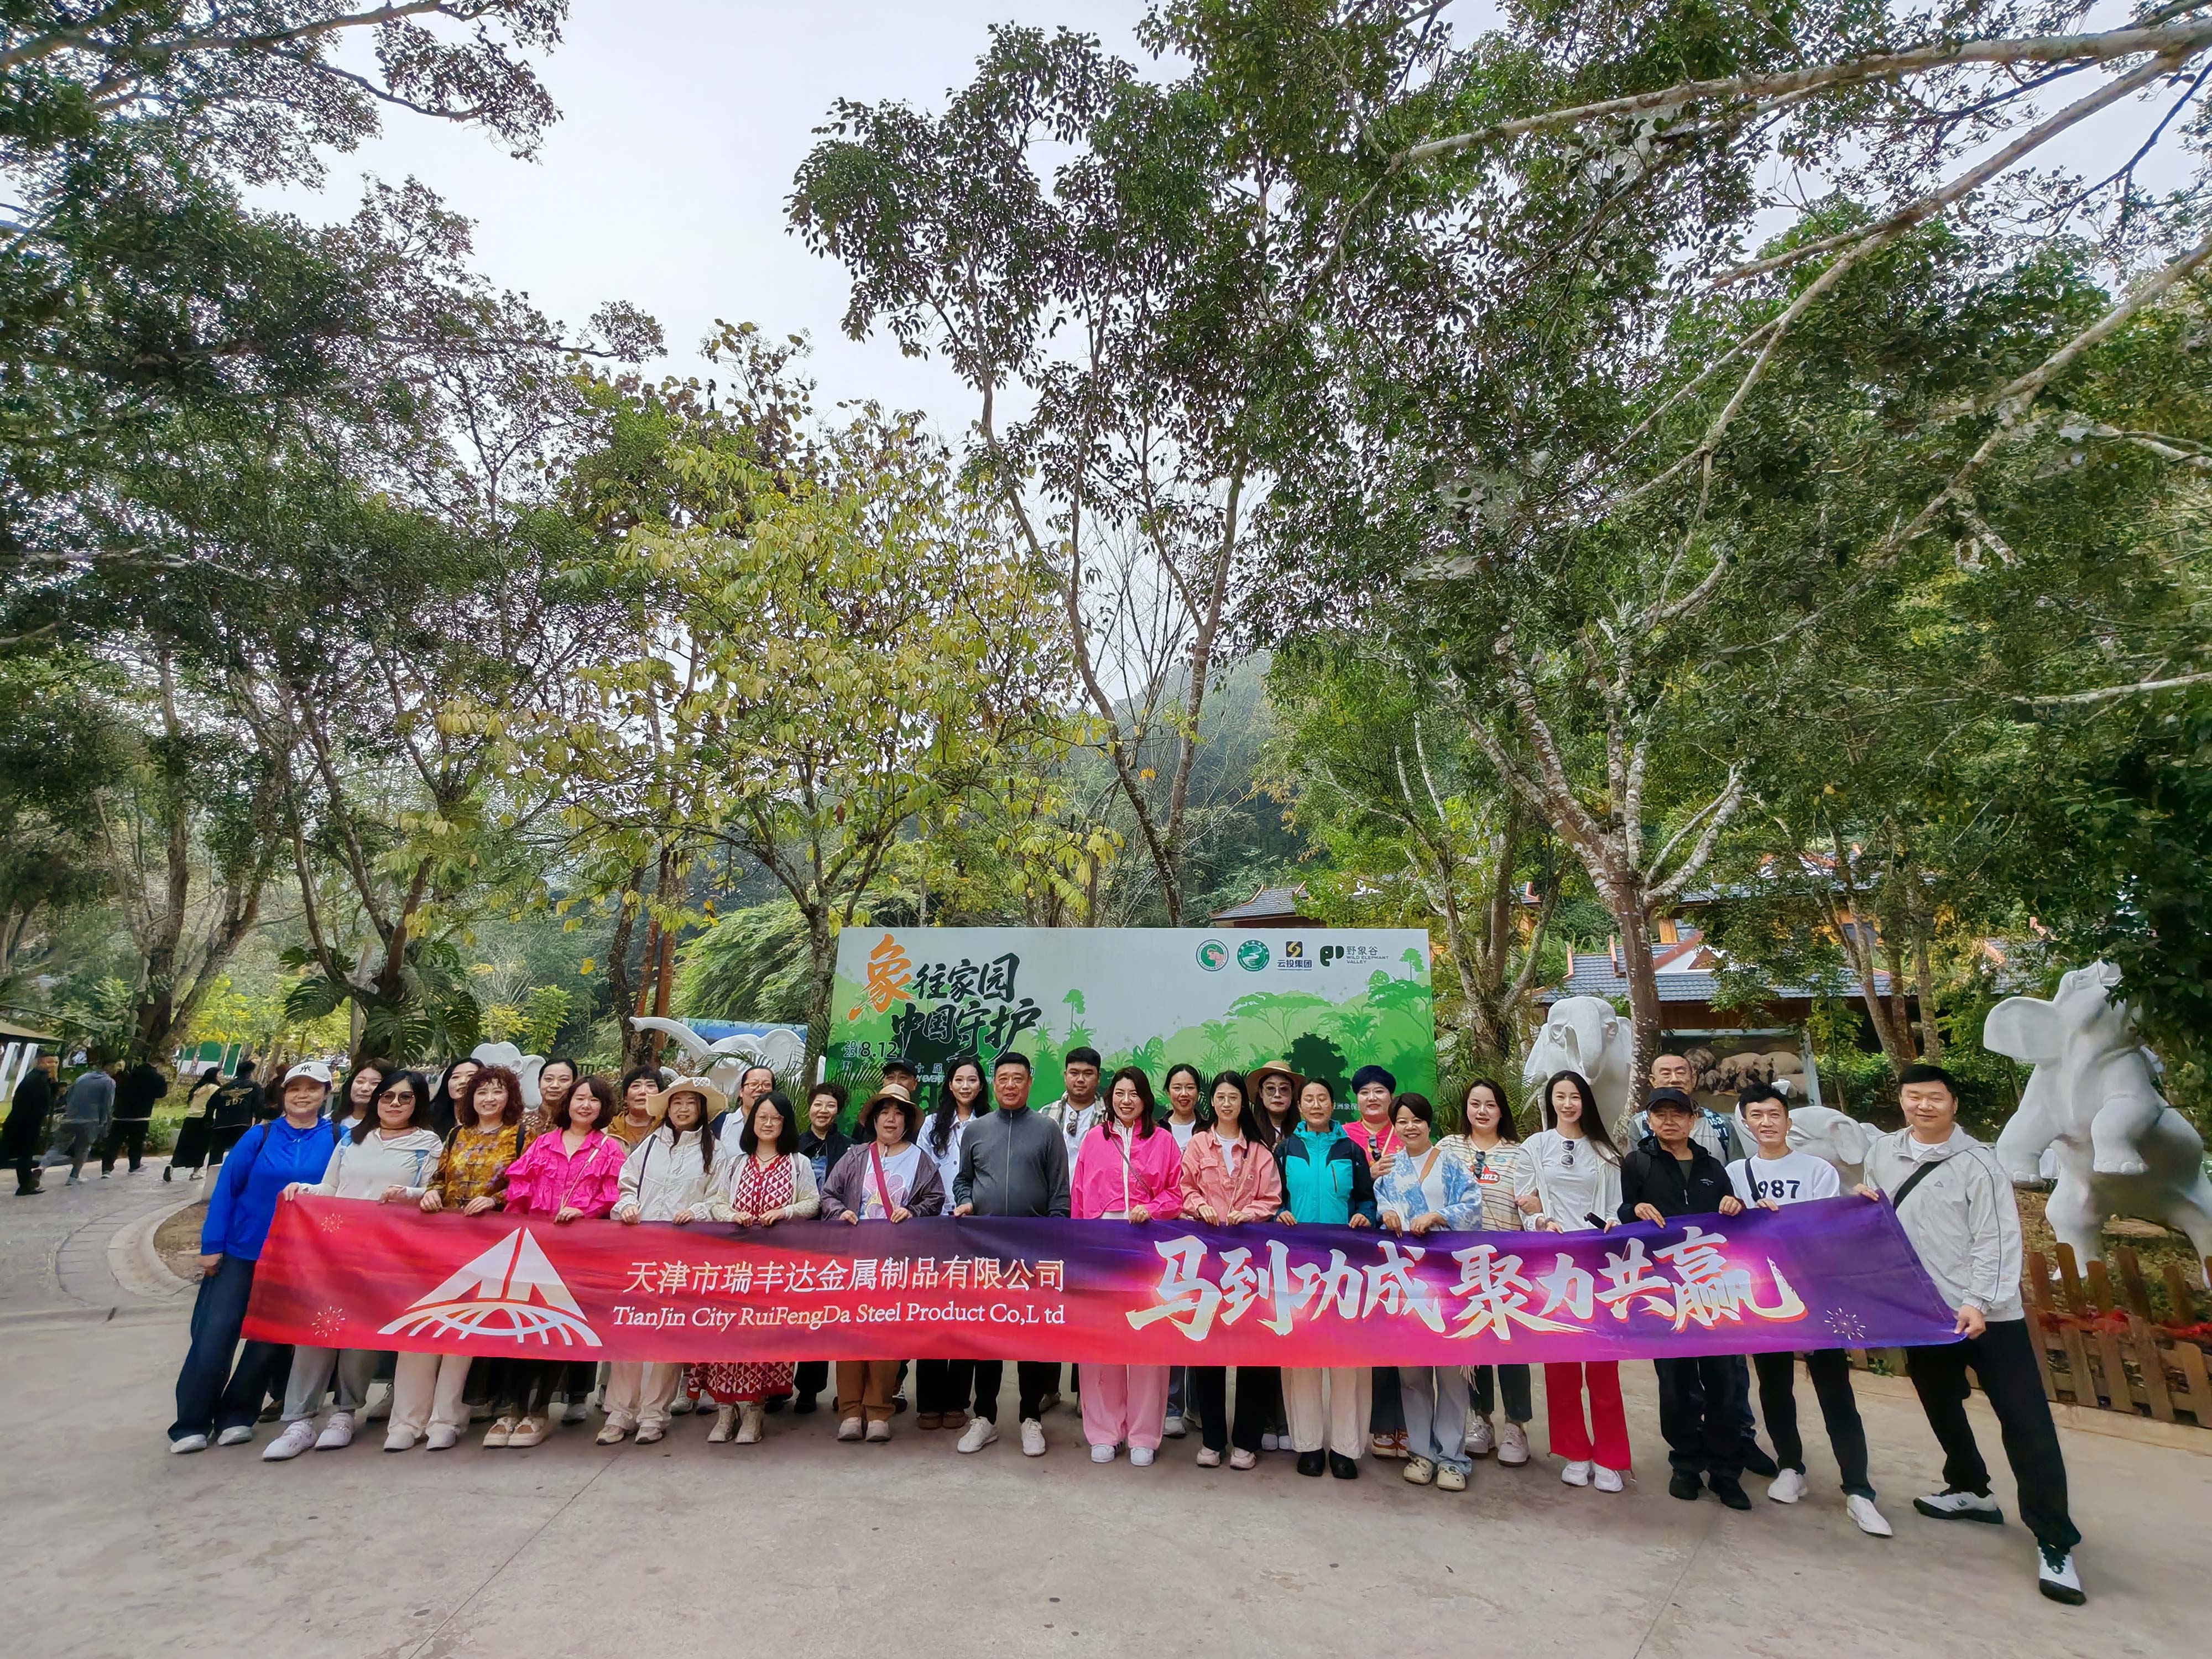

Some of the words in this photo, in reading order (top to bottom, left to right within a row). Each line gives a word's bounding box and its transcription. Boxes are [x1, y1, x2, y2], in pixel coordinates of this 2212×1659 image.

[1277, 959, 1312, 968] 云投集团
[1346, 946, 1378, 955] 野象谷
[891, 998, 1042, 1062] 中国守护
[860, 1041, 898, 1058] 8.12
[622, 1254, 1065, 1295] 天津市瑞丰达金属制品有限公司
[1125, 1235, 1446, 1342] 马到功成
[1441, 1226, 1807, 1342] 聚力共赢
[613, 1306, 686, 1330] TianJin
[692, 1306, 737, 1332] City
[738, 1305, 851, 1331] RuiFengDa
[856, 1301, 901, 1323] Steel
[906, 1301, 985, 1322] Product
